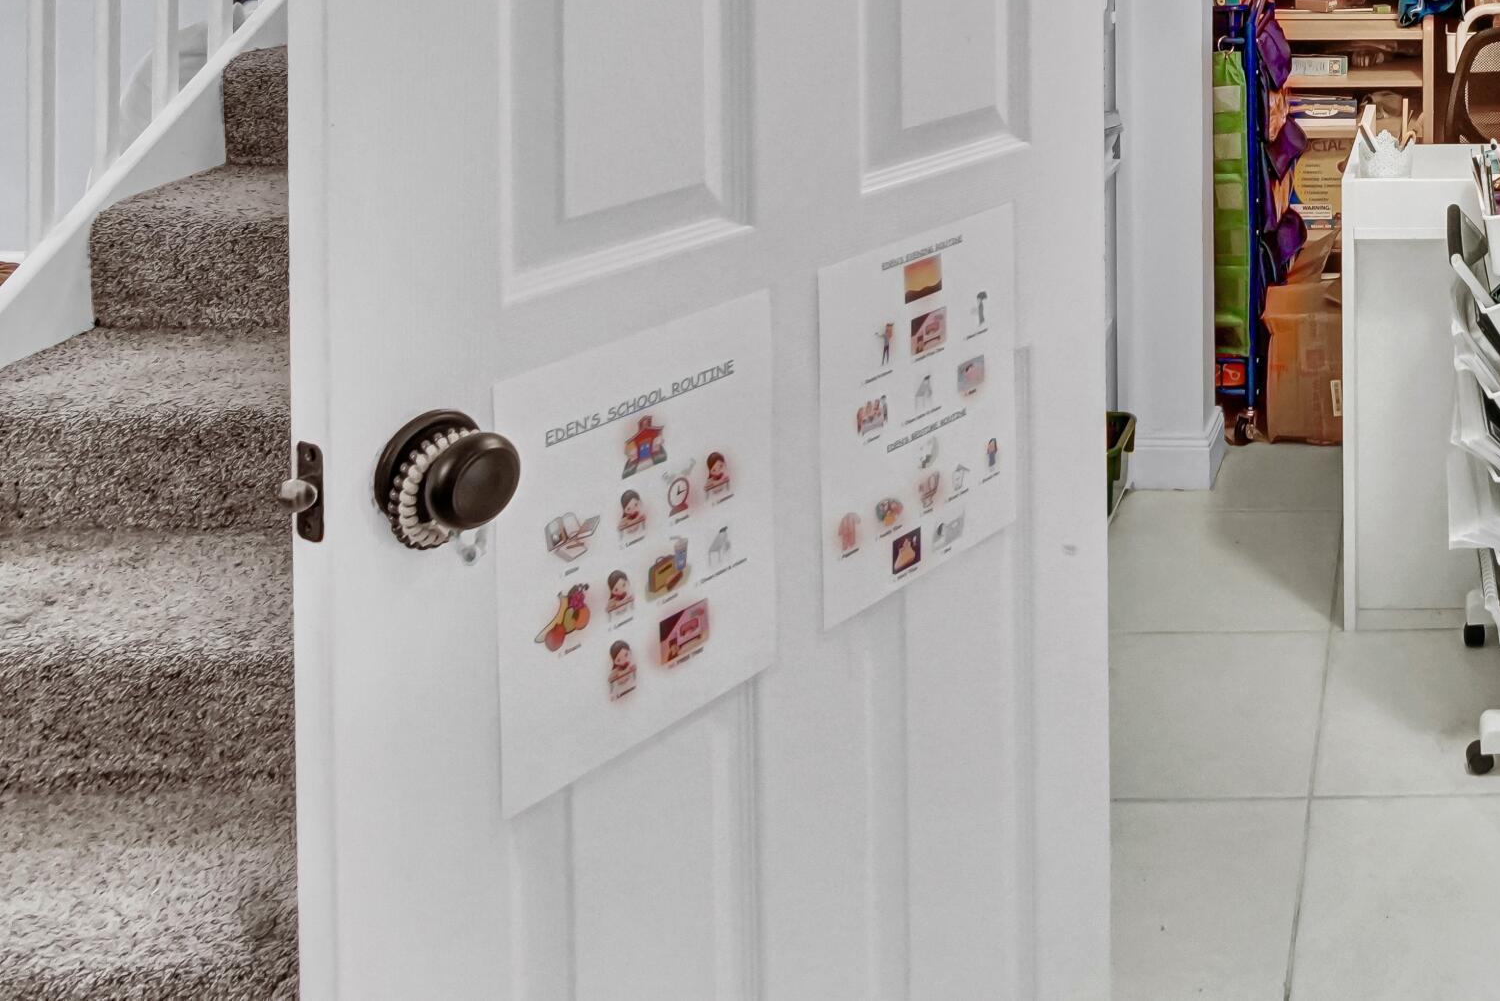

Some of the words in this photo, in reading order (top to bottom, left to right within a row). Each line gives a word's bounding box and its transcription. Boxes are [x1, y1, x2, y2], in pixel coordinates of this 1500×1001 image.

[545, 412, 601, 446] EDEN'S
[607, 387, 666, 422] SCHOOL
[671, 359, 735, 396] ROUTINE
